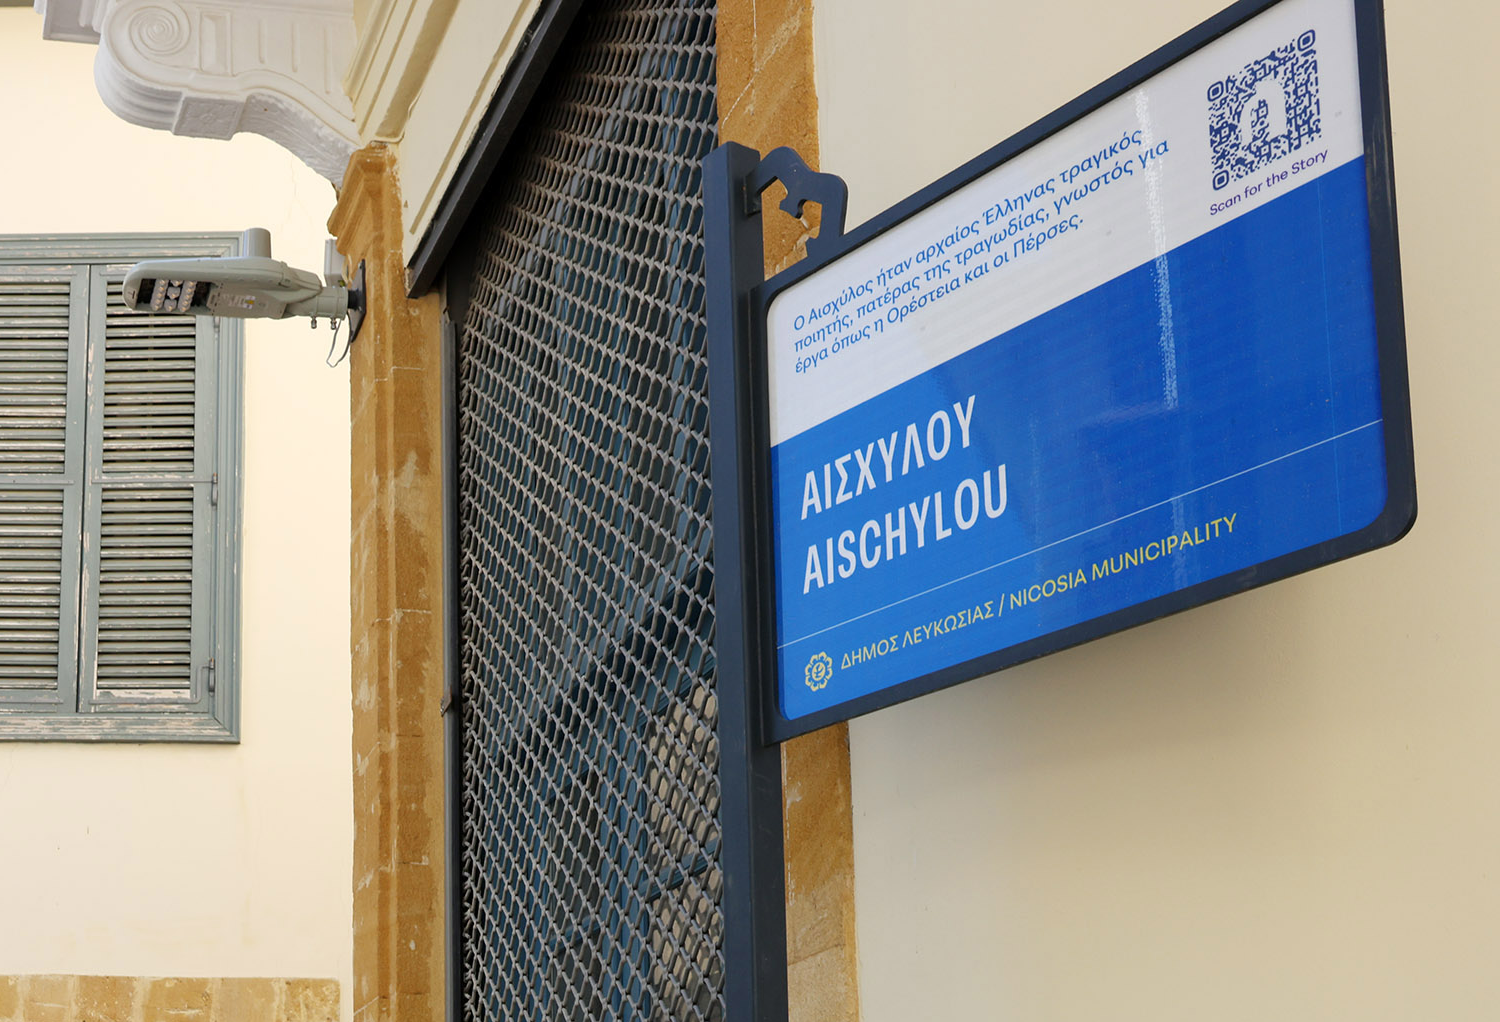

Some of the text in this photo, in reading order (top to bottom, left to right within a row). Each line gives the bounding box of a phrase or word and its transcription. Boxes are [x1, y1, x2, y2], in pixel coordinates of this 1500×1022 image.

[793, 129, 1142, 332] Ο Αισχύλος ήταν αρχαίος Έλληνας τραγικός
[794, 140, 1169, 353] ποιητής, πατέρας της τραγωδίας, γνωστός για
[1209, 149, 1329, 216] Scan for the Story
[795, 213, 1084, 374] έργα όπως η Ορέστεια και οι Πέρσες.
[801, 394, 976, 521] ΑΙΣΧΥΛΟΥ
[803, 463, 1008, 595] AISCHYLOU
[840, 512, 1238, 671] ΔΗΜΟΣ ΛΕΥΚΩΣΙΑΣ / NICOSIA MUNICIPALITY
